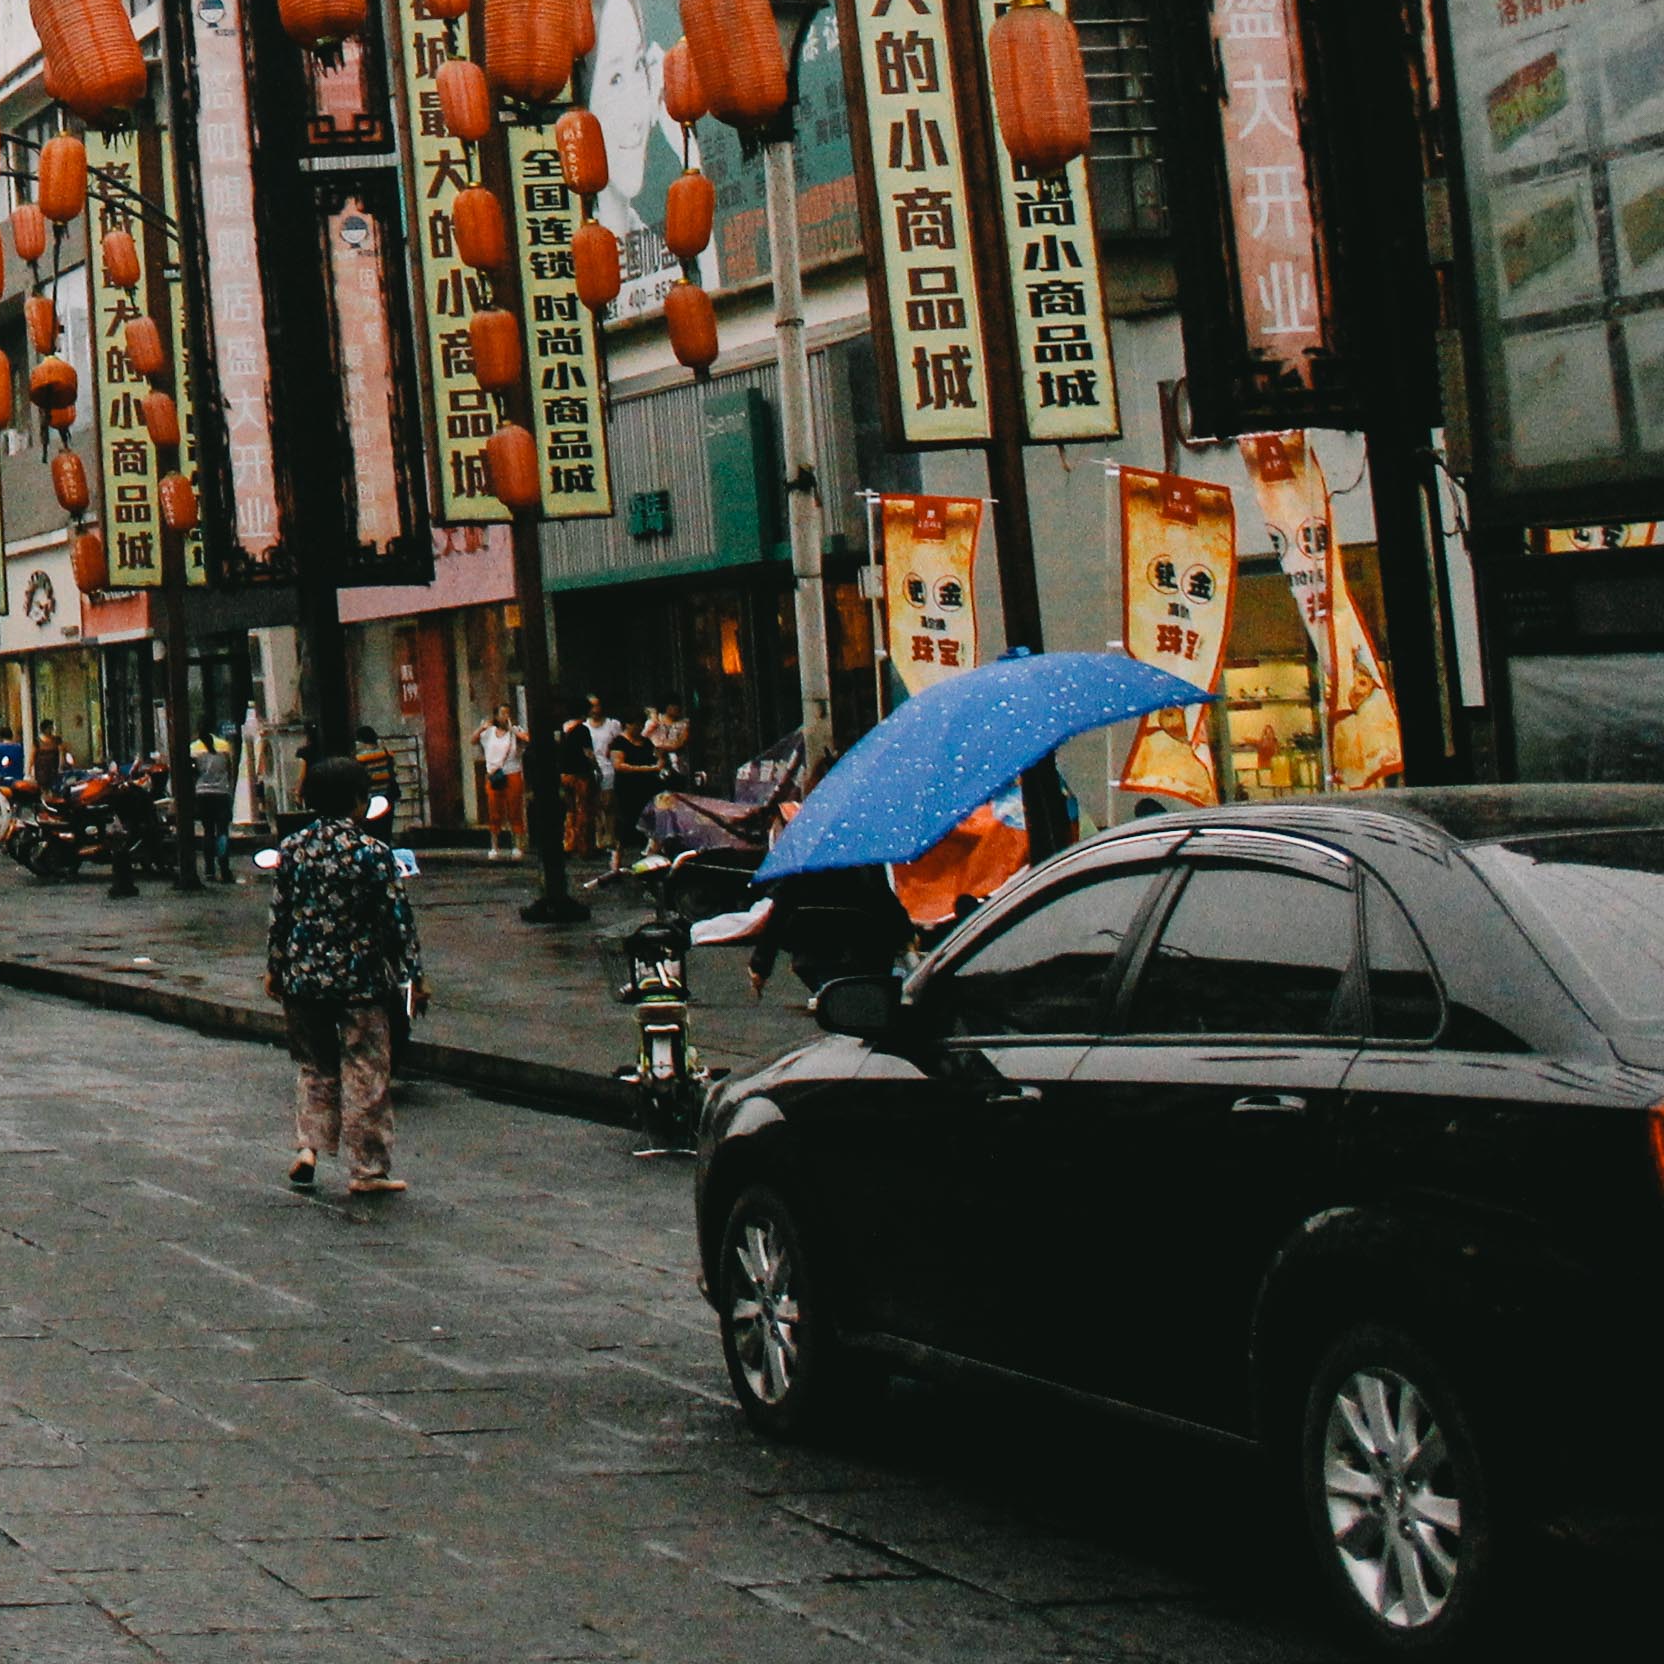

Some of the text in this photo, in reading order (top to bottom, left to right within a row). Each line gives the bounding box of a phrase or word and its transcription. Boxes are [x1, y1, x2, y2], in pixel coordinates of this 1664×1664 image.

[521, 149, 596, 494] 全国连锁时尚小商品城
[911, 635, 962, 669] 珠宝
